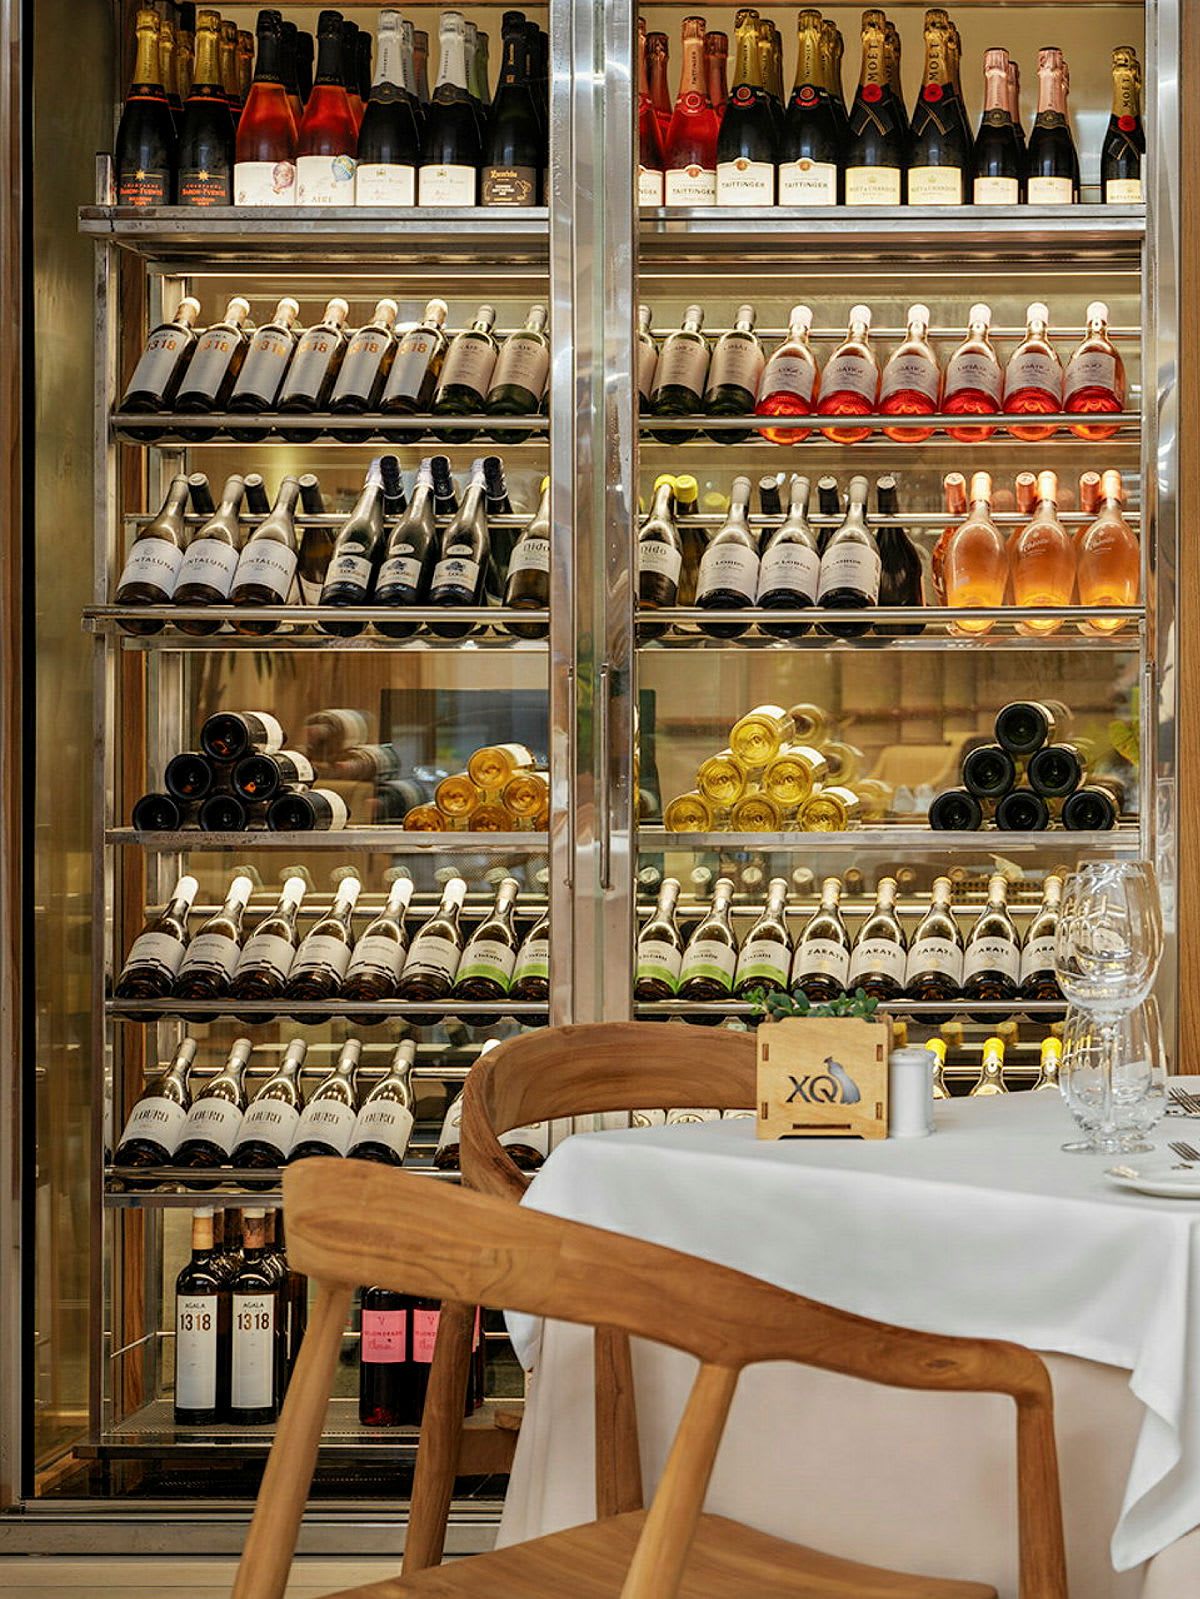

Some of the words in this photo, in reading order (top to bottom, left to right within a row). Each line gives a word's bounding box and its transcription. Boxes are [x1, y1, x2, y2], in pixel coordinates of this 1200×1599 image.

[721, 181, 765, 189] TAITTINGER
[785, 1074, 839, 1104] XQ
[180, 1313, 211, 1331] 1318
[237, 1313, 270, 1331] 1318
